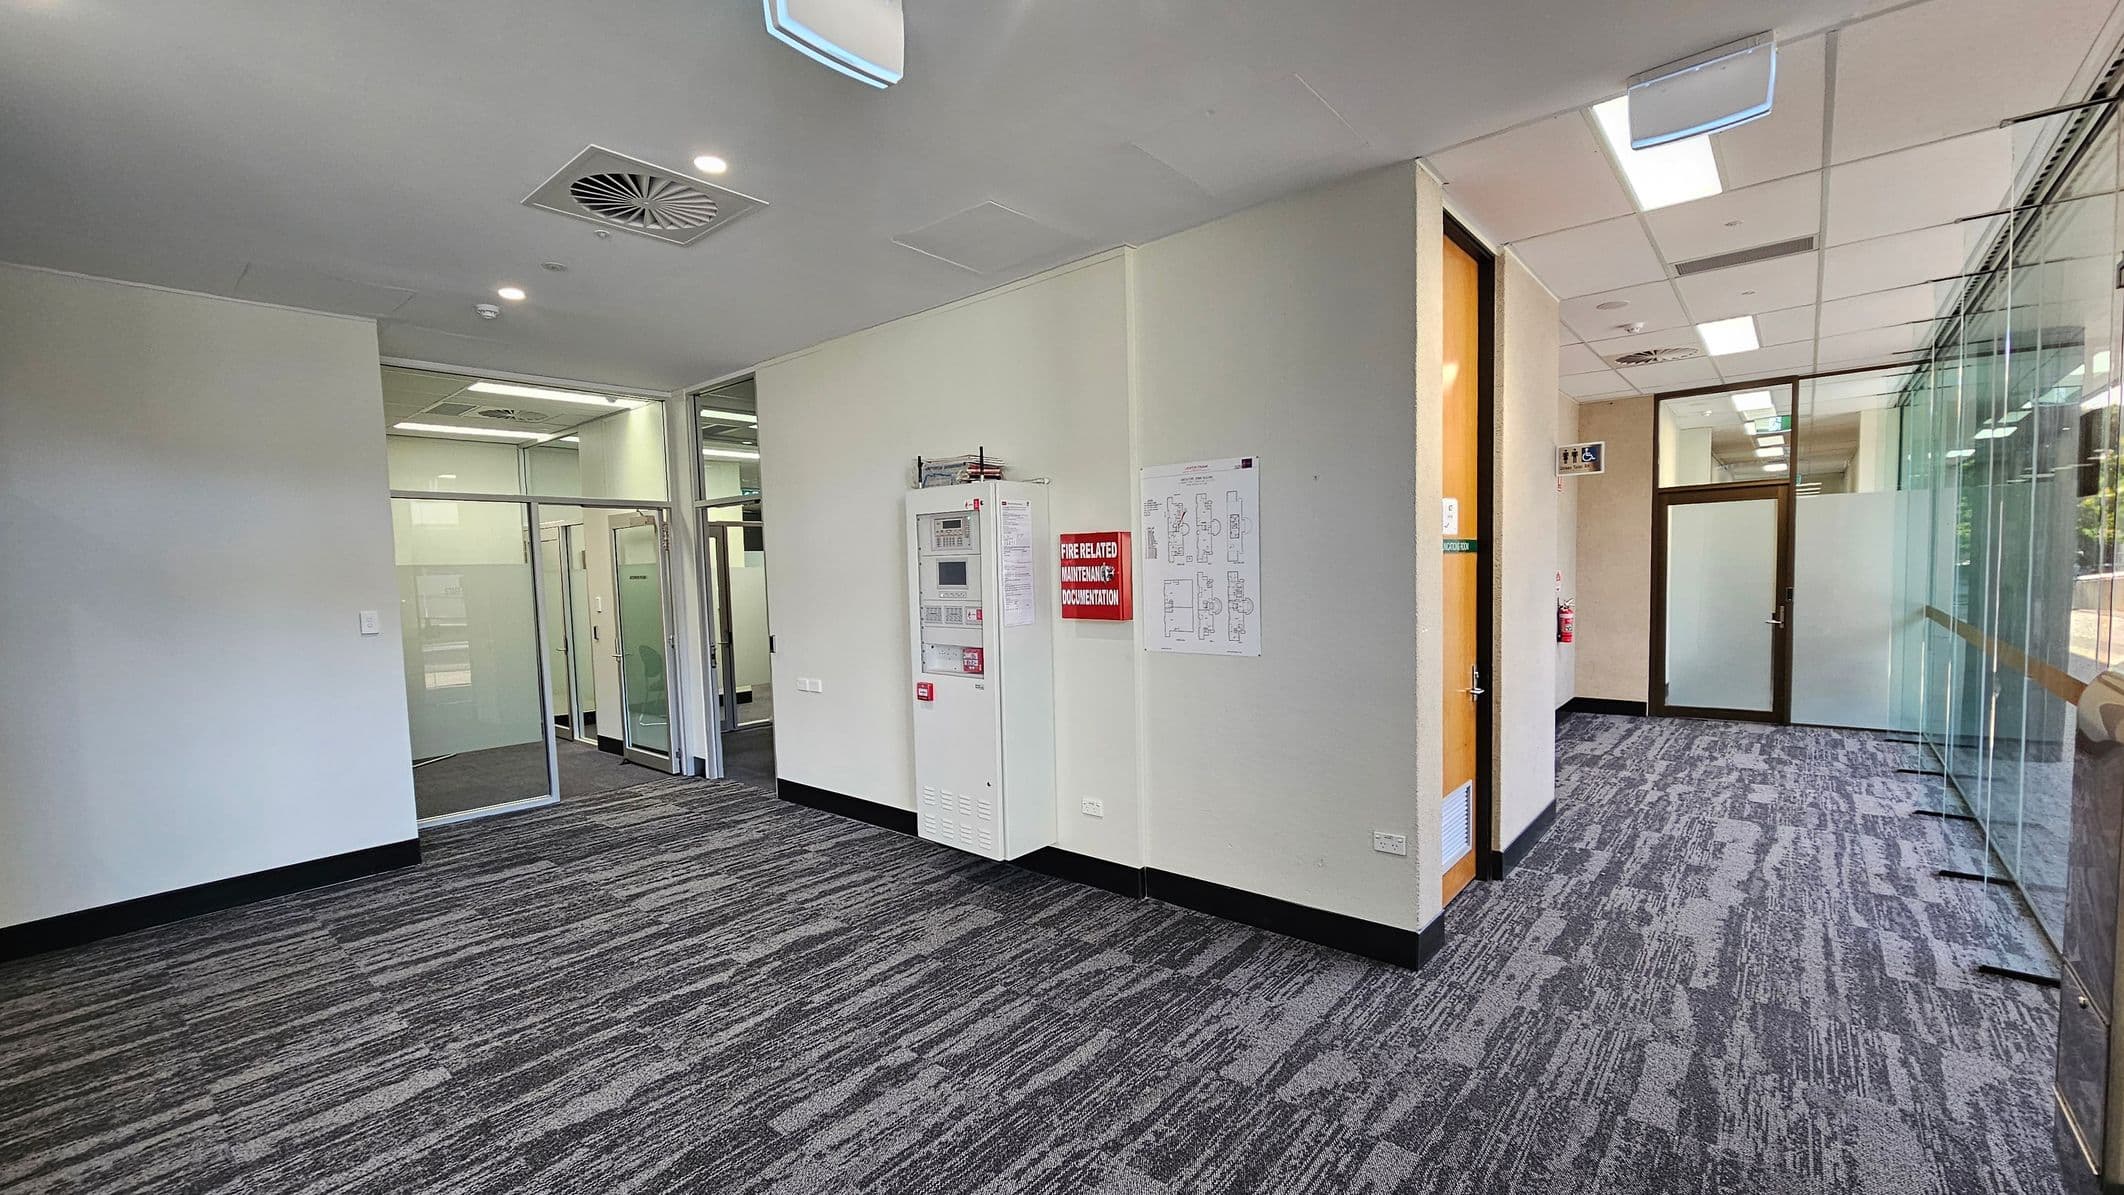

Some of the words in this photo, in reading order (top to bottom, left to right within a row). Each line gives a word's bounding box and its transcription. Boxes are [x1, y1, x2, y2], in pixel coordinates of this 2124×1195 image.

[1061, 543, 1079, 558] FIRE
[1080, 542, 1117, 558] RELATED
[1062, 589, 1118, 605] DOCUMENTATION
